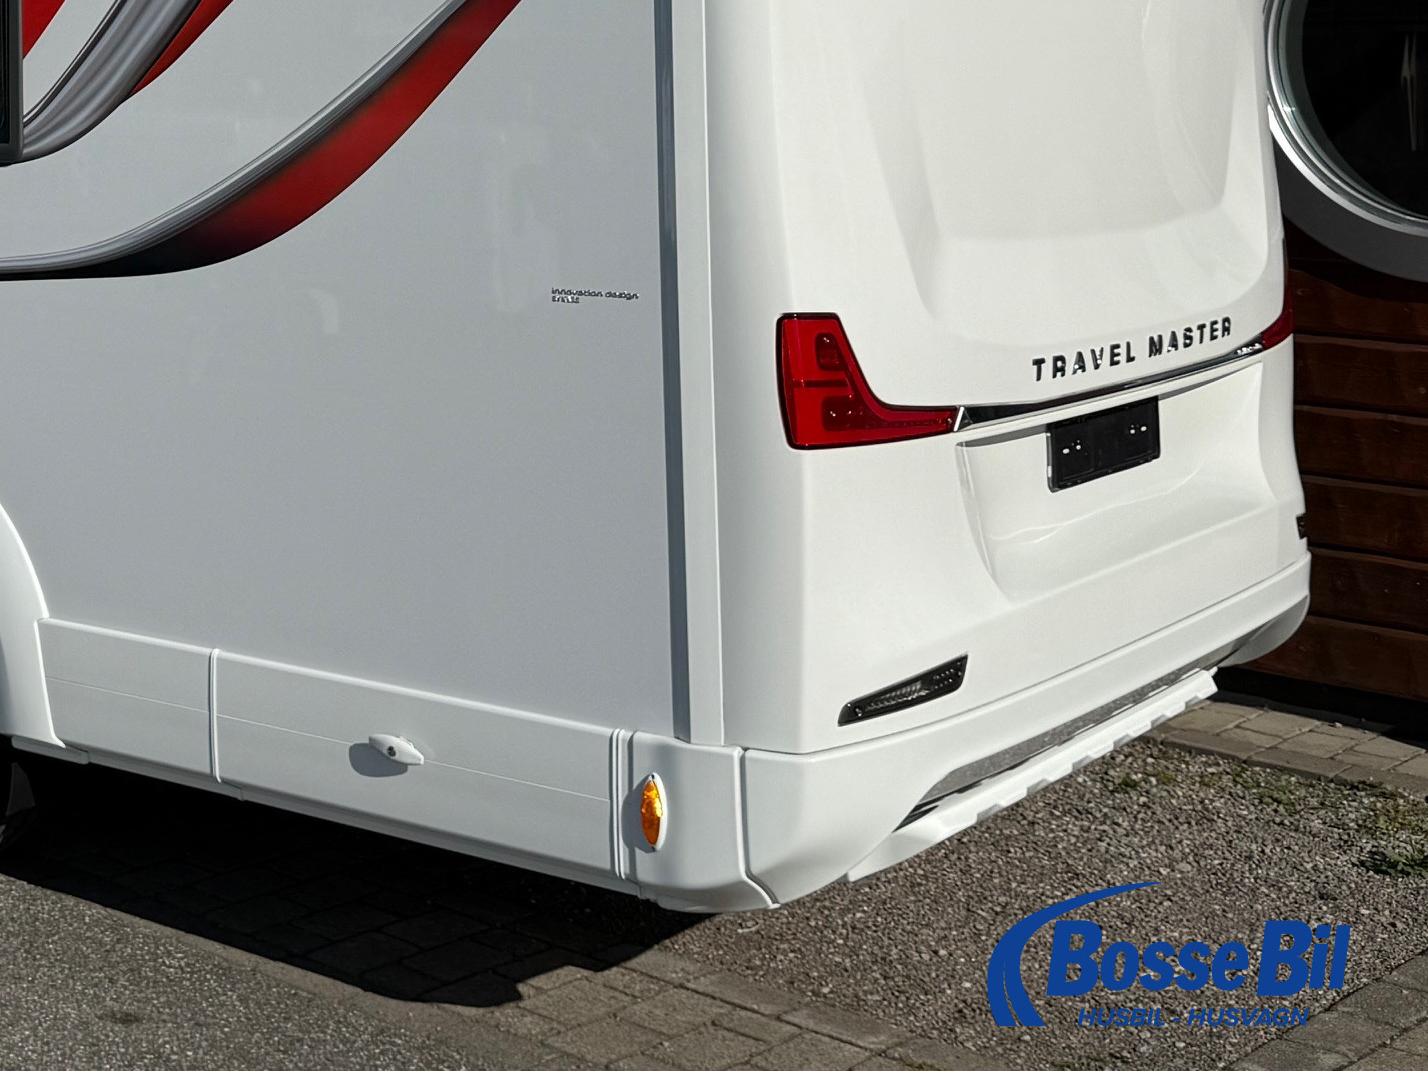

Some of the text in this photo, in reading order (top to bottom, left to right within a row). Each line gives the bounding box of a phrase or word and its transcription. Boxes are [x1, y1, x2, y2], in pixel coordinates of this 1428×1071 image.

[551, 287, 639, 301] innovation design
[1031, 316, 1232, 382] TRAVEL MASTER
